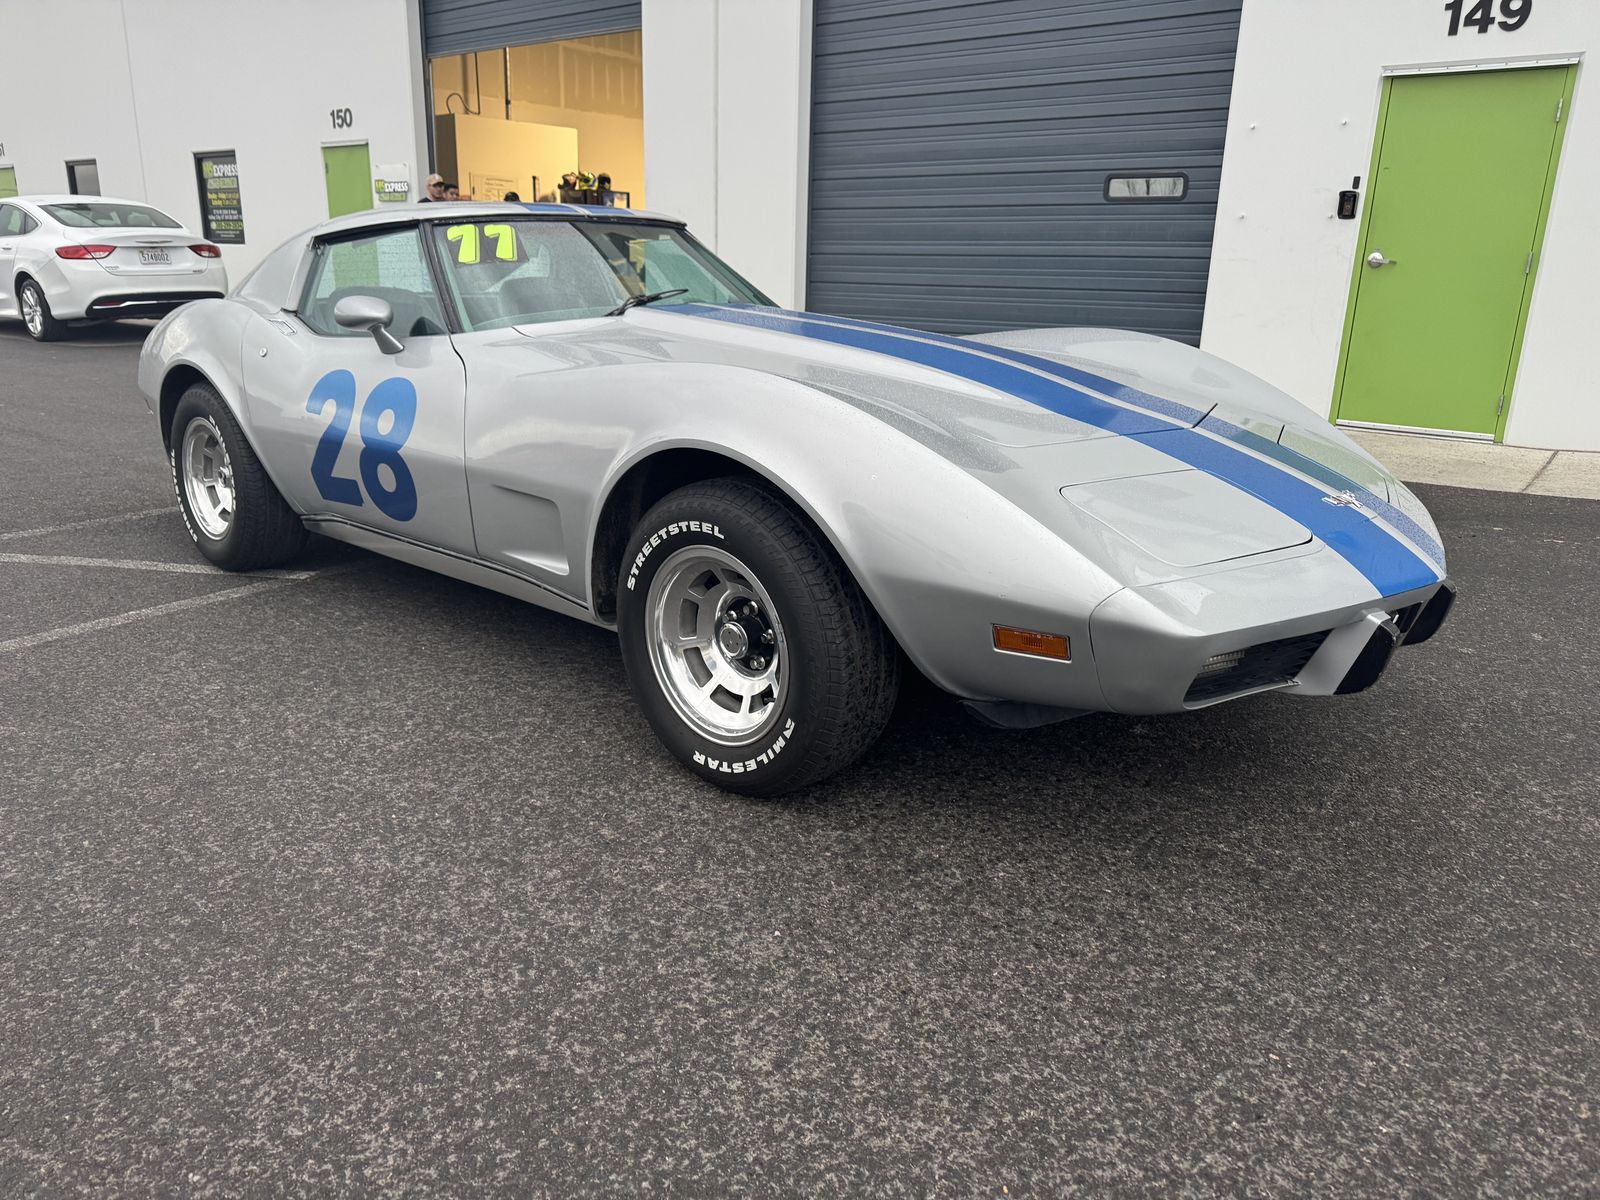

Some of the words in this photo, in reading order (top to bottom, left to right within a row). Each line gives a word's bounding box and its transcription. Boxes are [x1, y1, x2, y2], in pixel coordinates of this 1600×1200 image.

[1445, 0, 1532, 36] 149
[330, 108, 353, 129] 150
[447, 224, 518, 264] 77
[306, 369, 418, 522] 28
[627, 520, 725, 591] STREETSTEEL
[693, 735, 786, 774] MILESTAR
